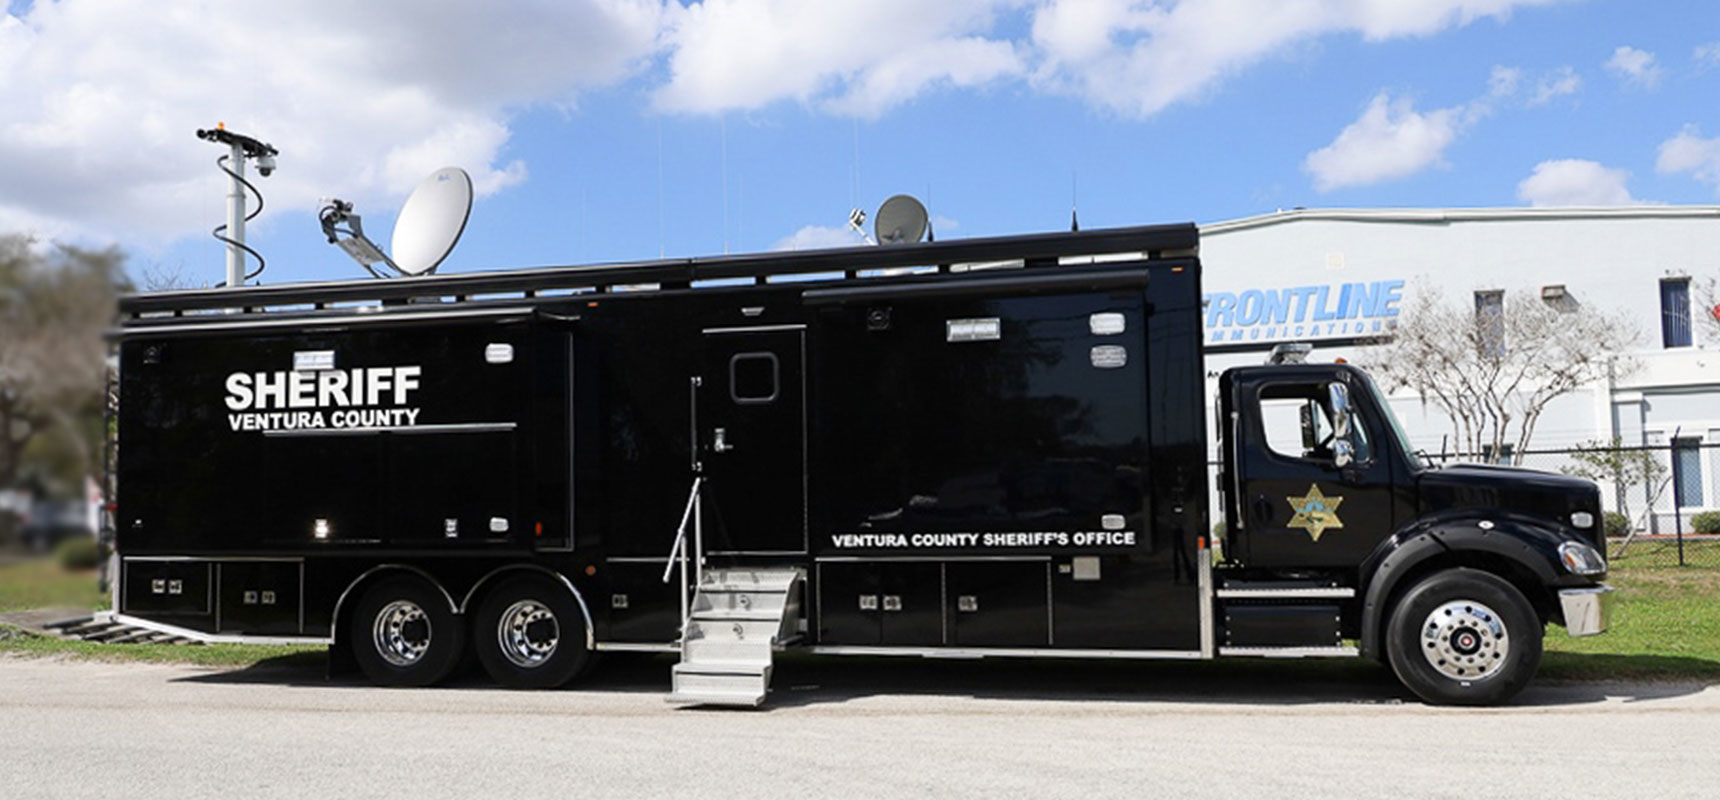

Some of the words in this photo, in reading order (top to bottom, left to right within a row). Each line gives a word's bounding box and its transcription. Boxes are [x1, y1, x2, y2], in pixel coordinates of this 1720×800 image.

[1211, 319, 1398, 342] MMUNICATION
[225, 365, 421, 410] SHERIFF
[228, 411, 326, 431] VENTURA
[331, 408, 420, 428] COUNTY
[832, 534, 908, 547] VENTURA
[911, 533, 979, 547] COUNTY
[983, 532, 1069, 546] SHERIFF'S
[1073, 532, 1135, 545] OFFICE
